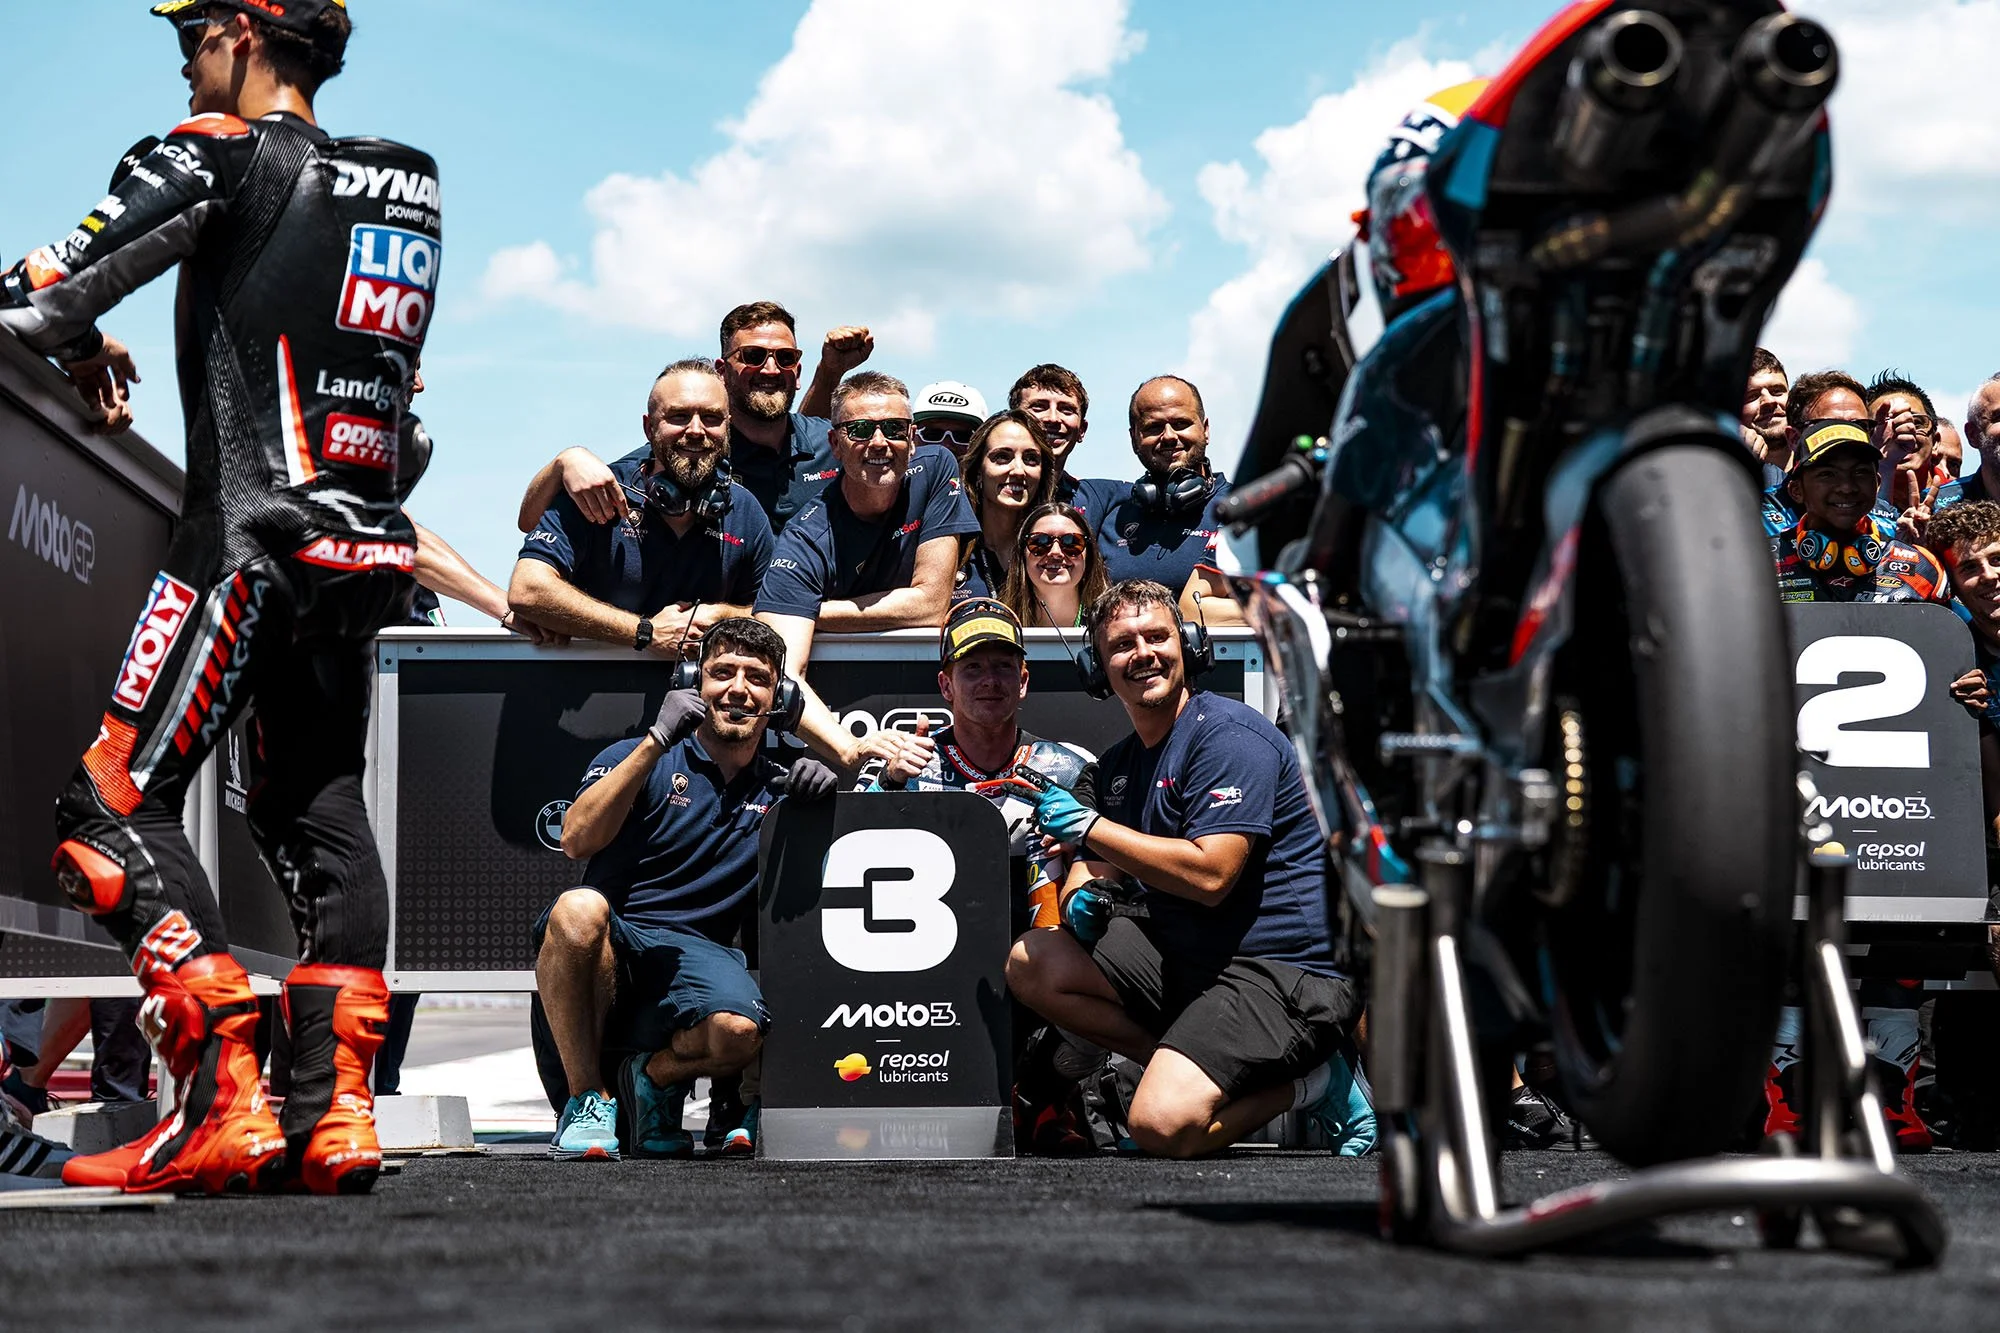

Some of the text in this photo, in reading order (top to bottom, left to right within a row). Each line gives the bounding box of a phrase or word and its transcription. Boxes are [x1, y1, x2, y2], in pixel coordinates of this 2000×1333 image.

[385, 204, 424, 222] power
[348, 279, 430, 338] MO
[933, 395, 964, 405] HJC
[769, 558, 798, 570] LAZU
[119, 581, 188, 703] MOLY
[1796, 635, 1930, 768] 2
[1857, 841, 1926, 861] repsol
[1857, 858, 1926, 871] lubricants
[821, 828, 959, 973] 3
[879, 1050, 950, 1073] repsol
[879, 1069, 949, 1084] lubricants
